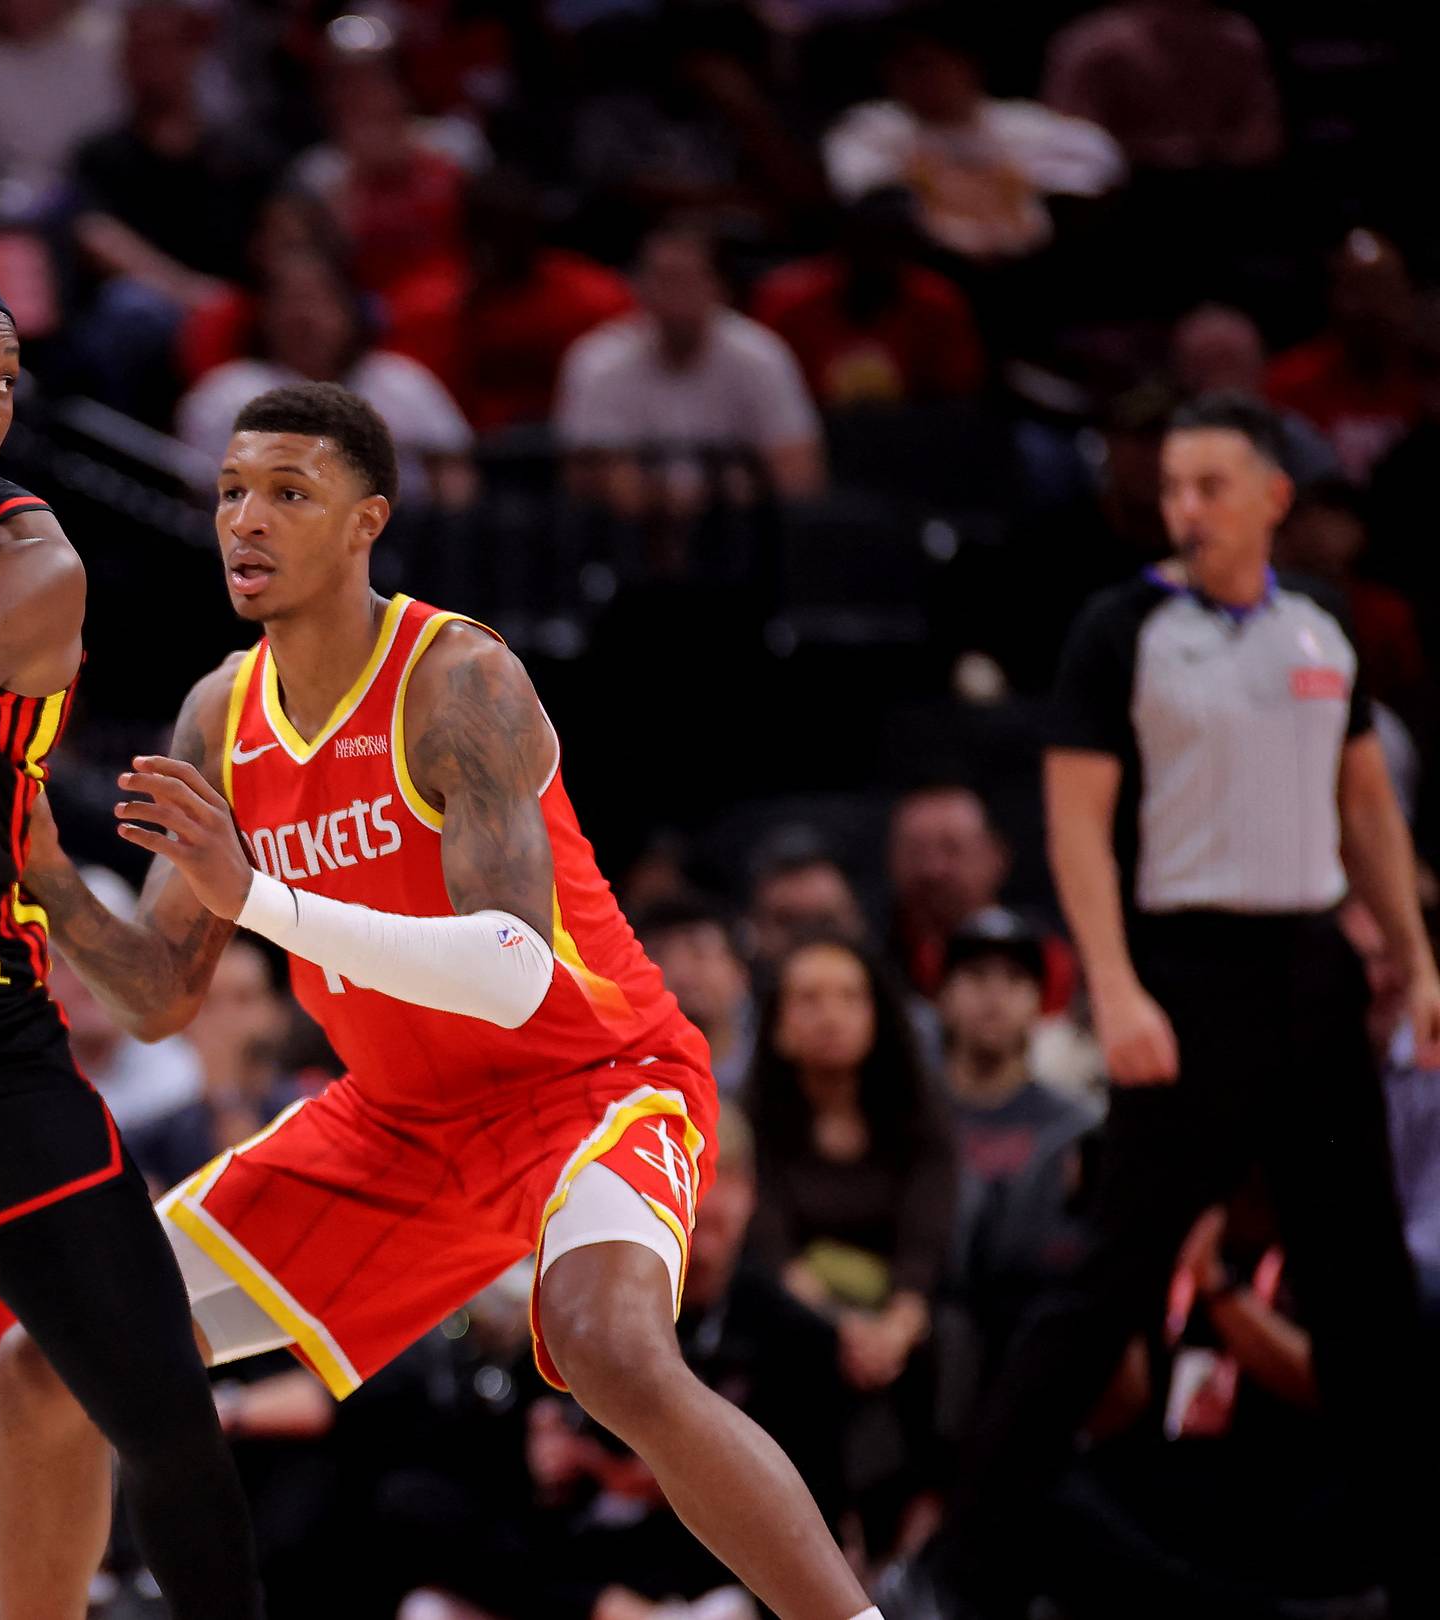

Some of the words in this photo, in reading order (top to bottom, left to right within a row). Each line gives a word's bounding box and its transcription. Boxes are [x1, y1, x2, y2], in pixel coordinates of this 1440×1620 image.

[335, 735, 387, 750] MEMORIAL
[335, 744, 388, 758] HERMANN
[242, 794, 402, 881] OCKETS
